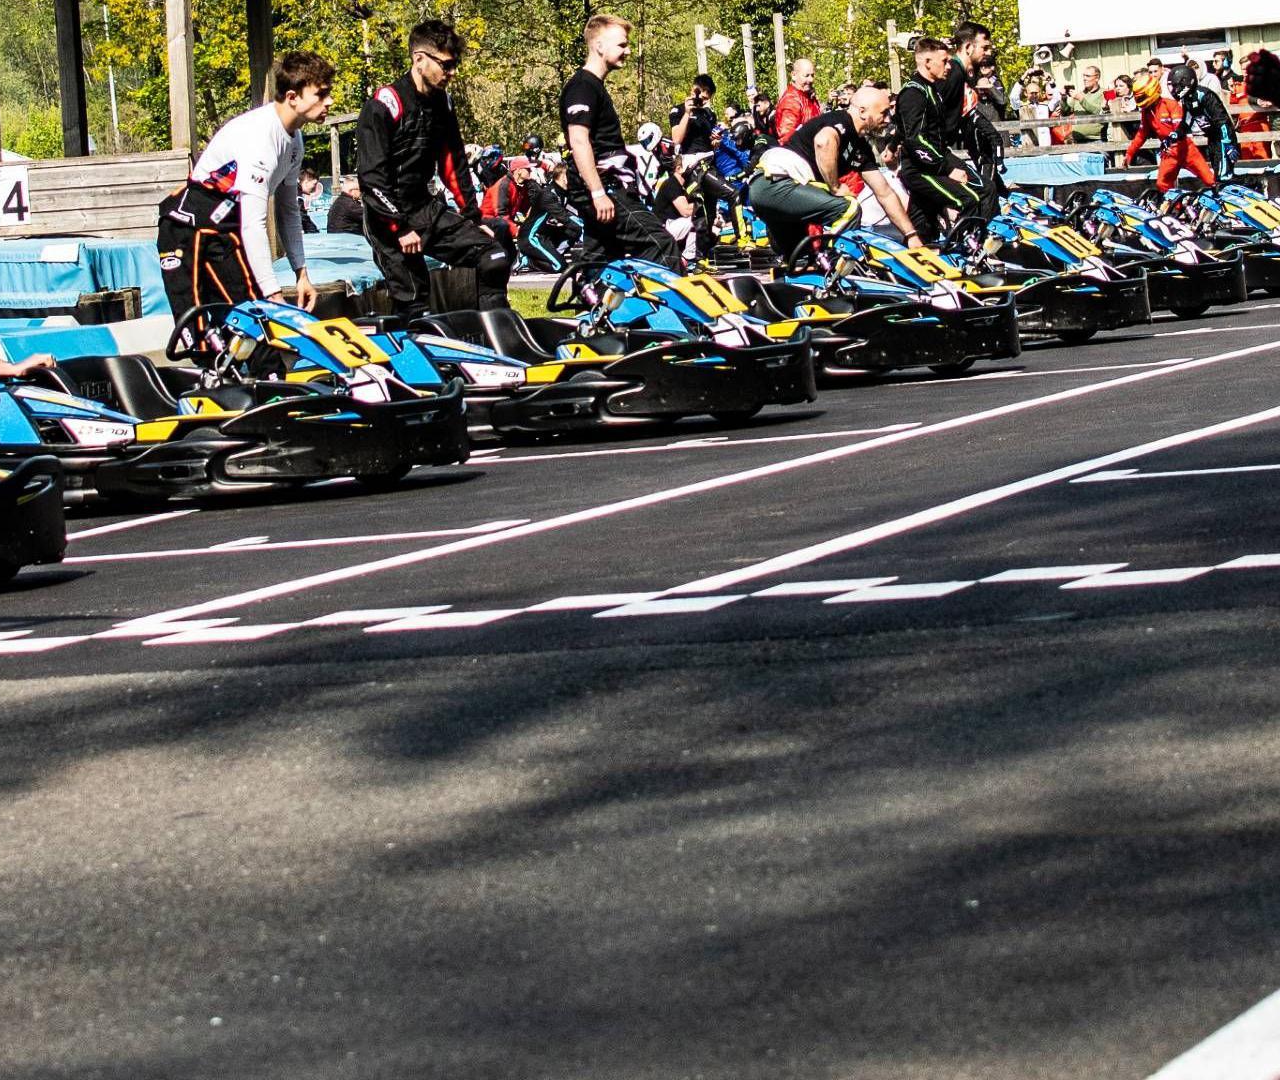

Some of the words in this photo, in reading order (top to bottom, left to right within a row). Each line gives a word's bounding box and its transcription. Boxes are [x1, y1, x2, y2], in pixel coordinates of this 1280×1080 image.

[2, 181, 28, 222] 4
[1148, 216, 1194, 242] 23
[908, 252, 946, 277] 5
[325, 325, 371, 361] 3
